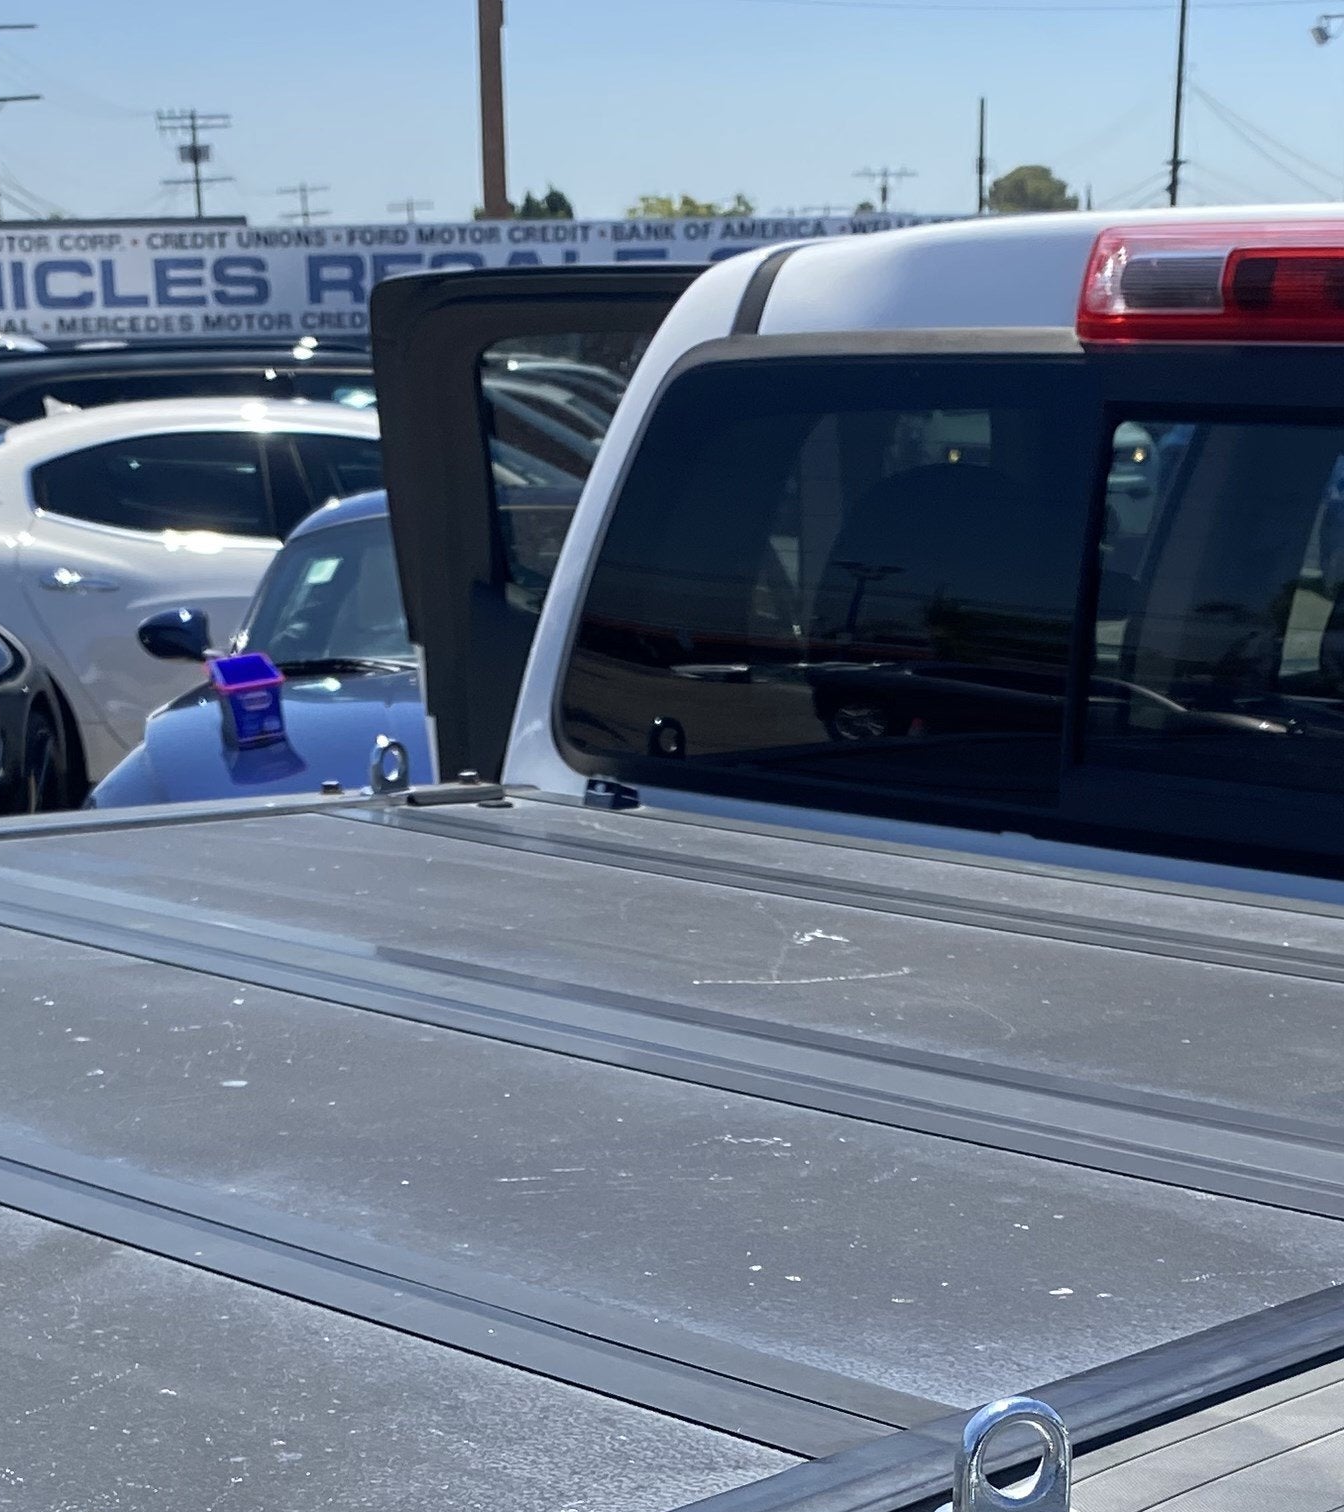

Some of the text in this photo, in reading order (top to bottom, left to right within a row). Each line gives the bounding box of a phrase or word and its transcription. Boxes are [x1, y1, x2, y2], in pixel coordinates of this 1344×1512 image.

[146, 231, 228, 250] CREDIT
[236, 229, 326, 249] UNIONS
[346, 227, 409, 246] FORD
[417, 226, 501, 245] MOTOR
[508, 224, 592, 244] CREDIT
[610, 223, 677, 242] BANK
[683, 222, 711, 241] OF
[720, 220, 829, 240] AMERICA
[57, 313, 195, 333] MERCEDES
[204, 312, 293, 331] MOTOR
[300, 310, 370, 330] CRED
